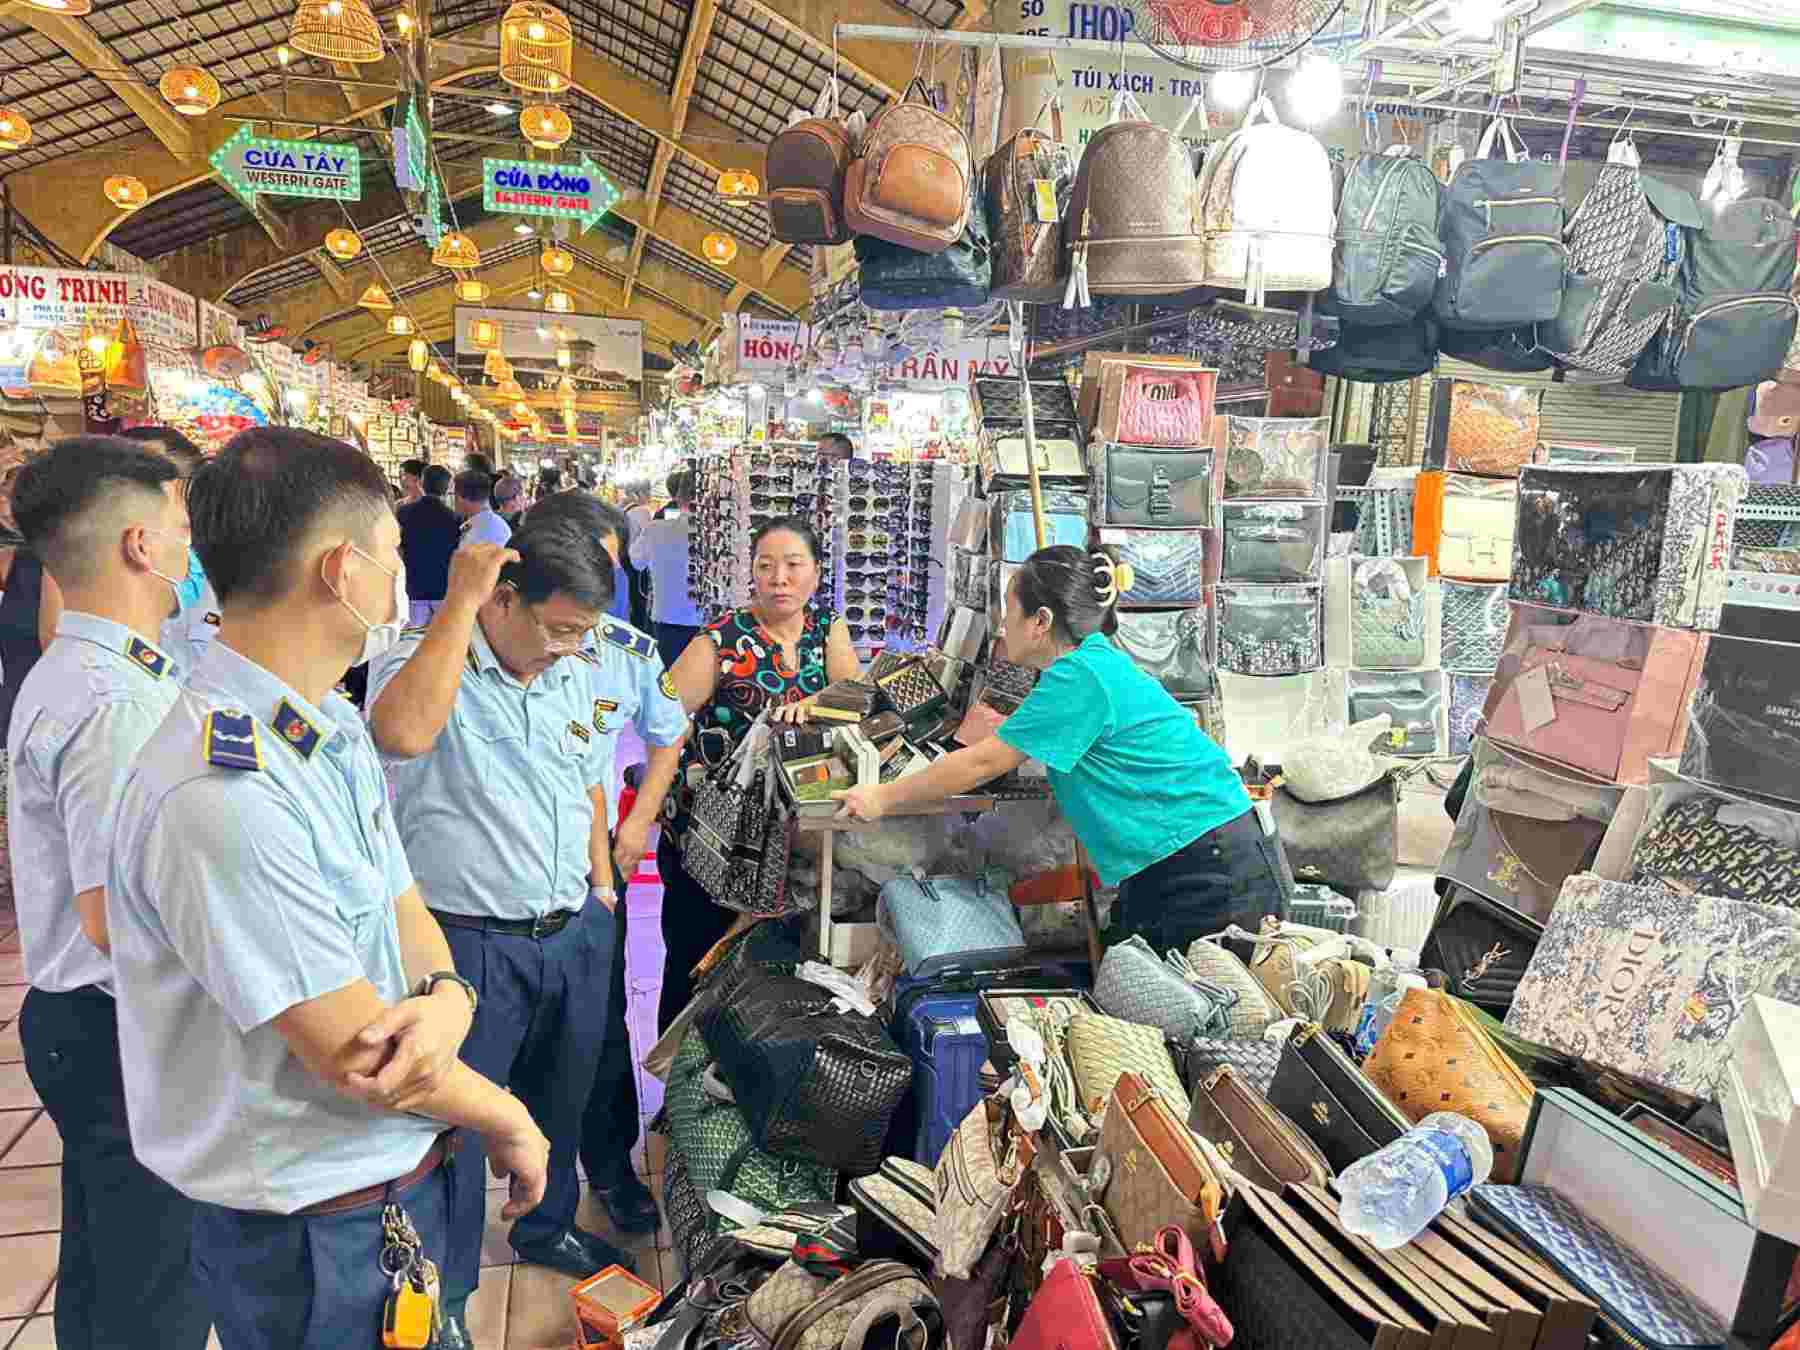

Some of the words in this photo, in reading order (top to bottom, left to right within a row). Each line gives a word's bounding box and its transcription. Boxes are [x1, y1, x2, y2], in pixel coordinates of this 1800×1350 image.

[1072, 65, 1101, 88] TÚI
[245, 146, 296, 169] CỬA
[304, 151, 346, 172] TÂY
[247, 171, 309, 186] WESTERN
[312, 176, 348, 190] GATE
[495, 167, 533, 188] CỬA
[57, 278, 129, 304] TRINH
[1596, 930, 1656, 1016] DIOR
